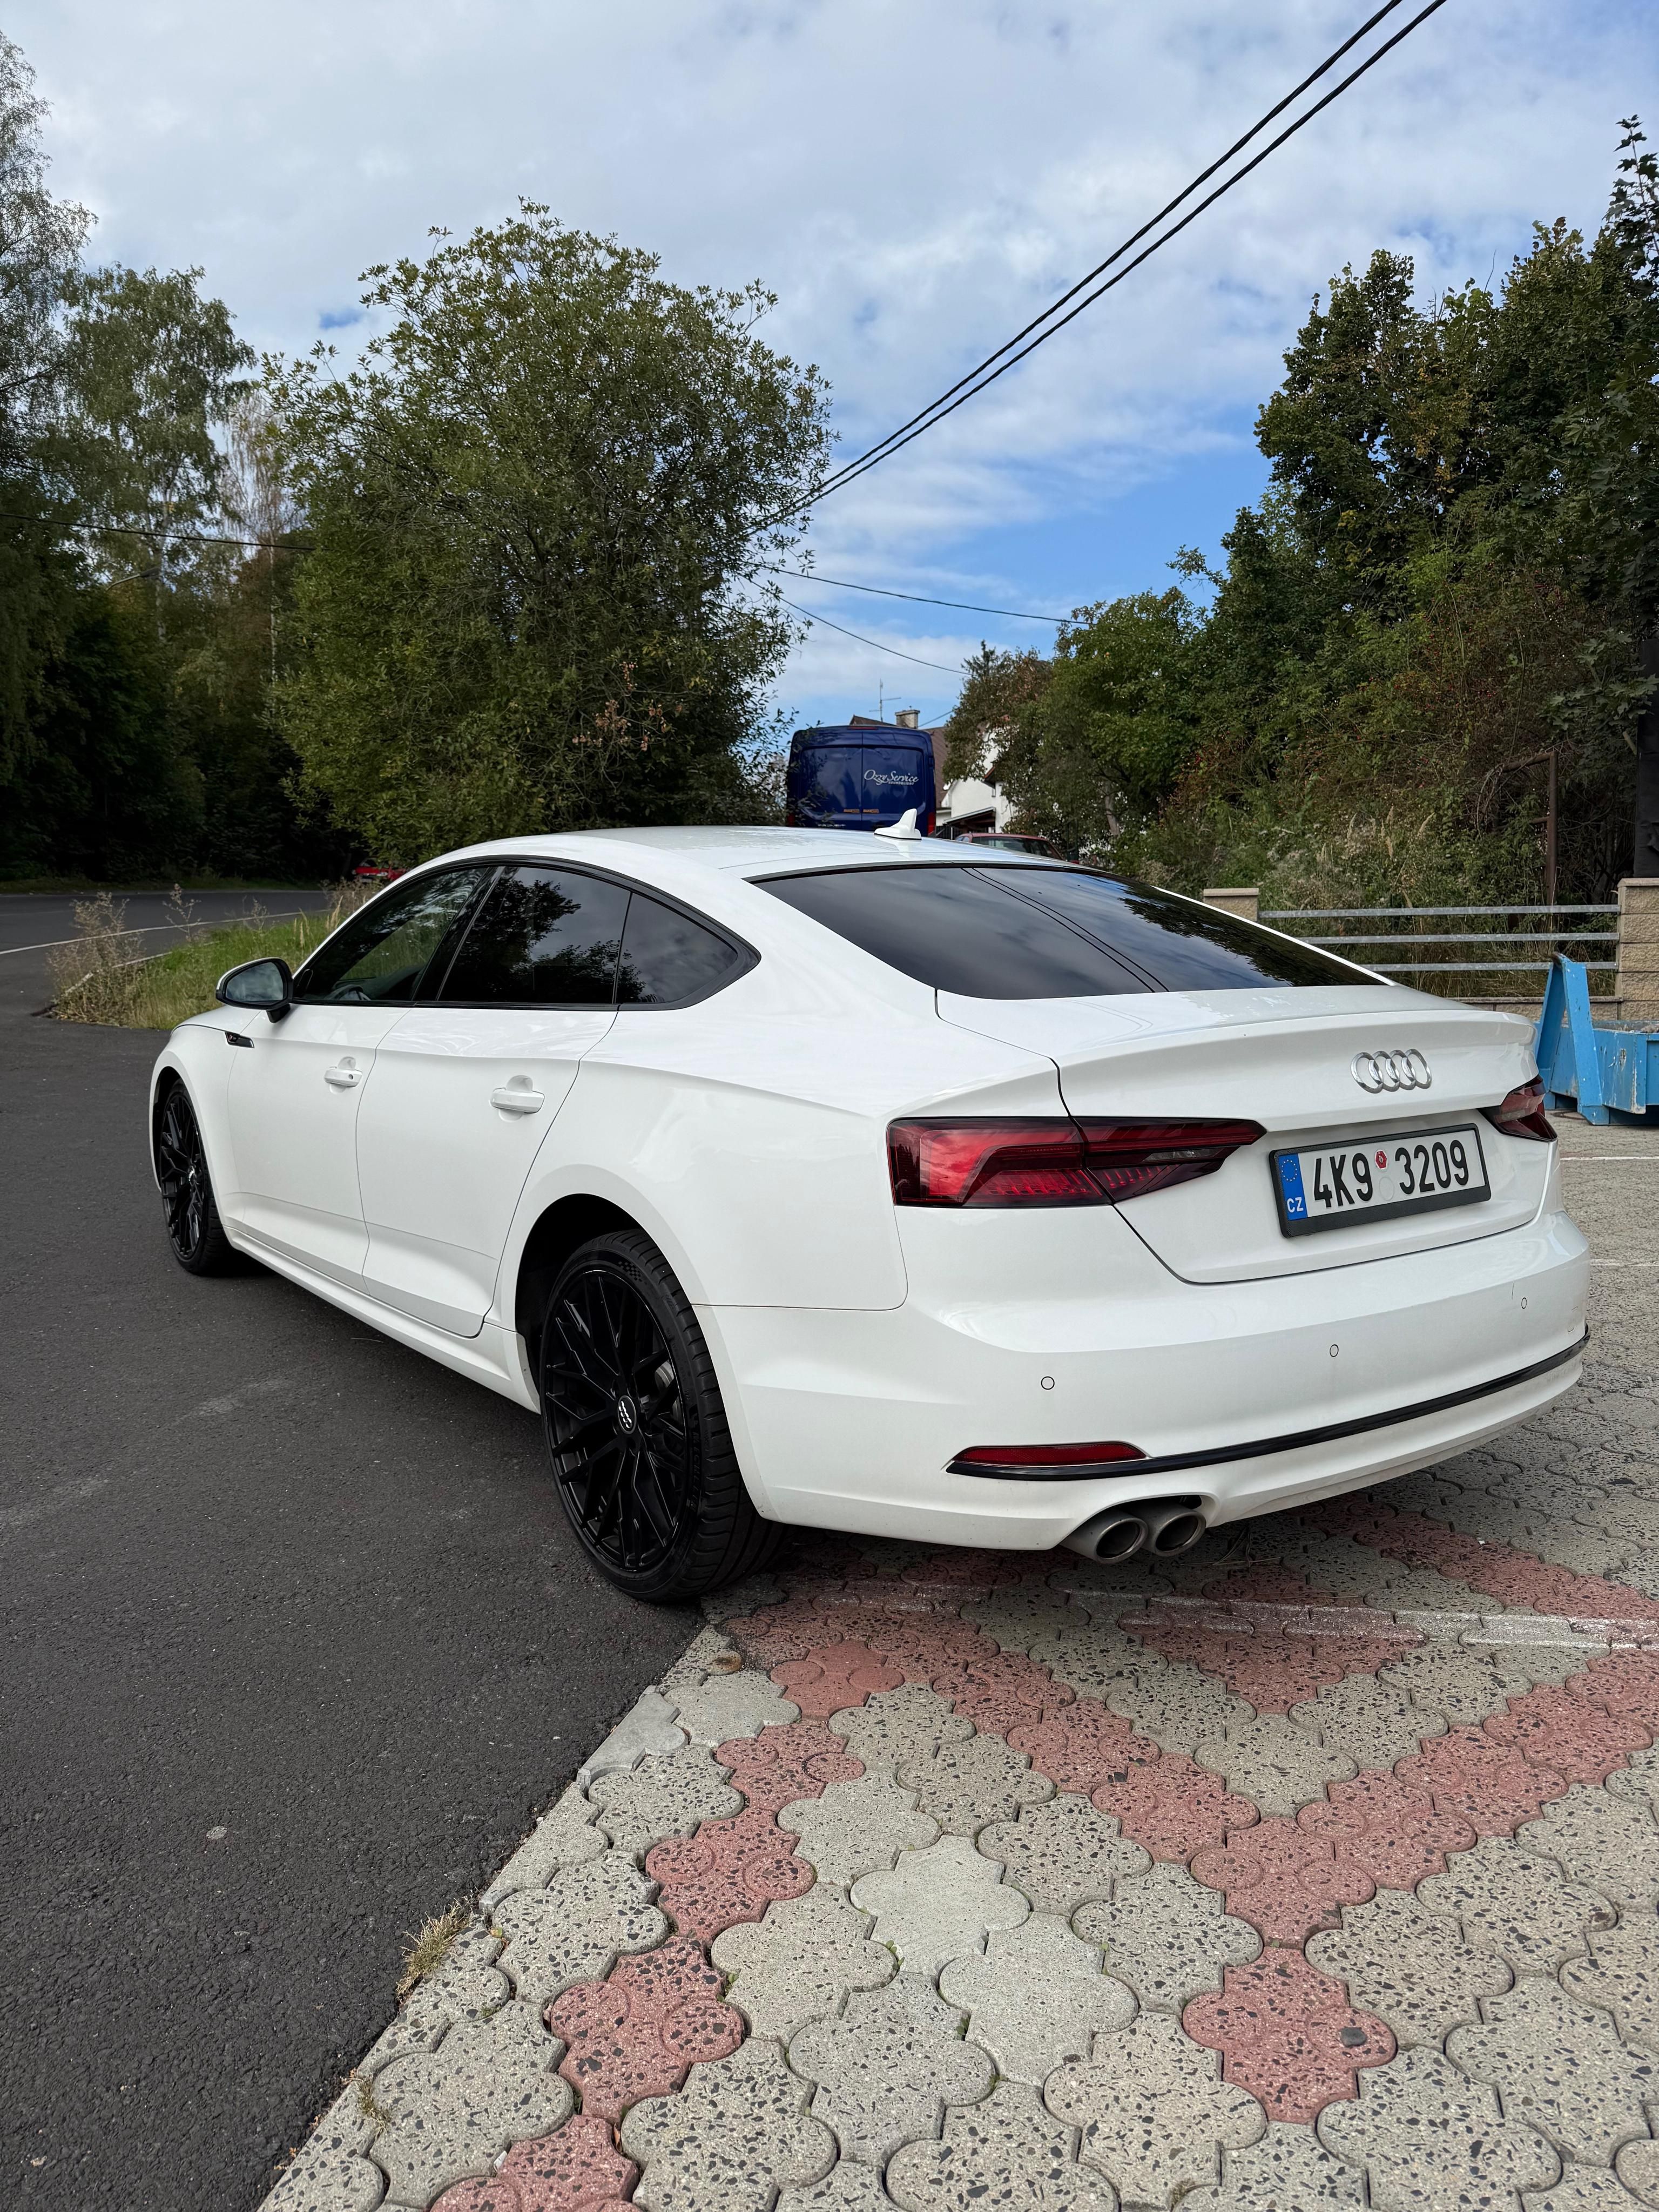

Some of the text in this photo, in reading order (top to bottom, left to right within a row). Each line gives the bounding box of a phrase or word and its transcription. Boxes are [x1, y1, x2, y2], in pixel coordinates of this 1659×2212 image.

[864, 770, 919, 785] Ozzy Service
[1313, 1139, 1469, 1208] 4K9 3209
[1287, 1197, 1304, 1213] CZ
